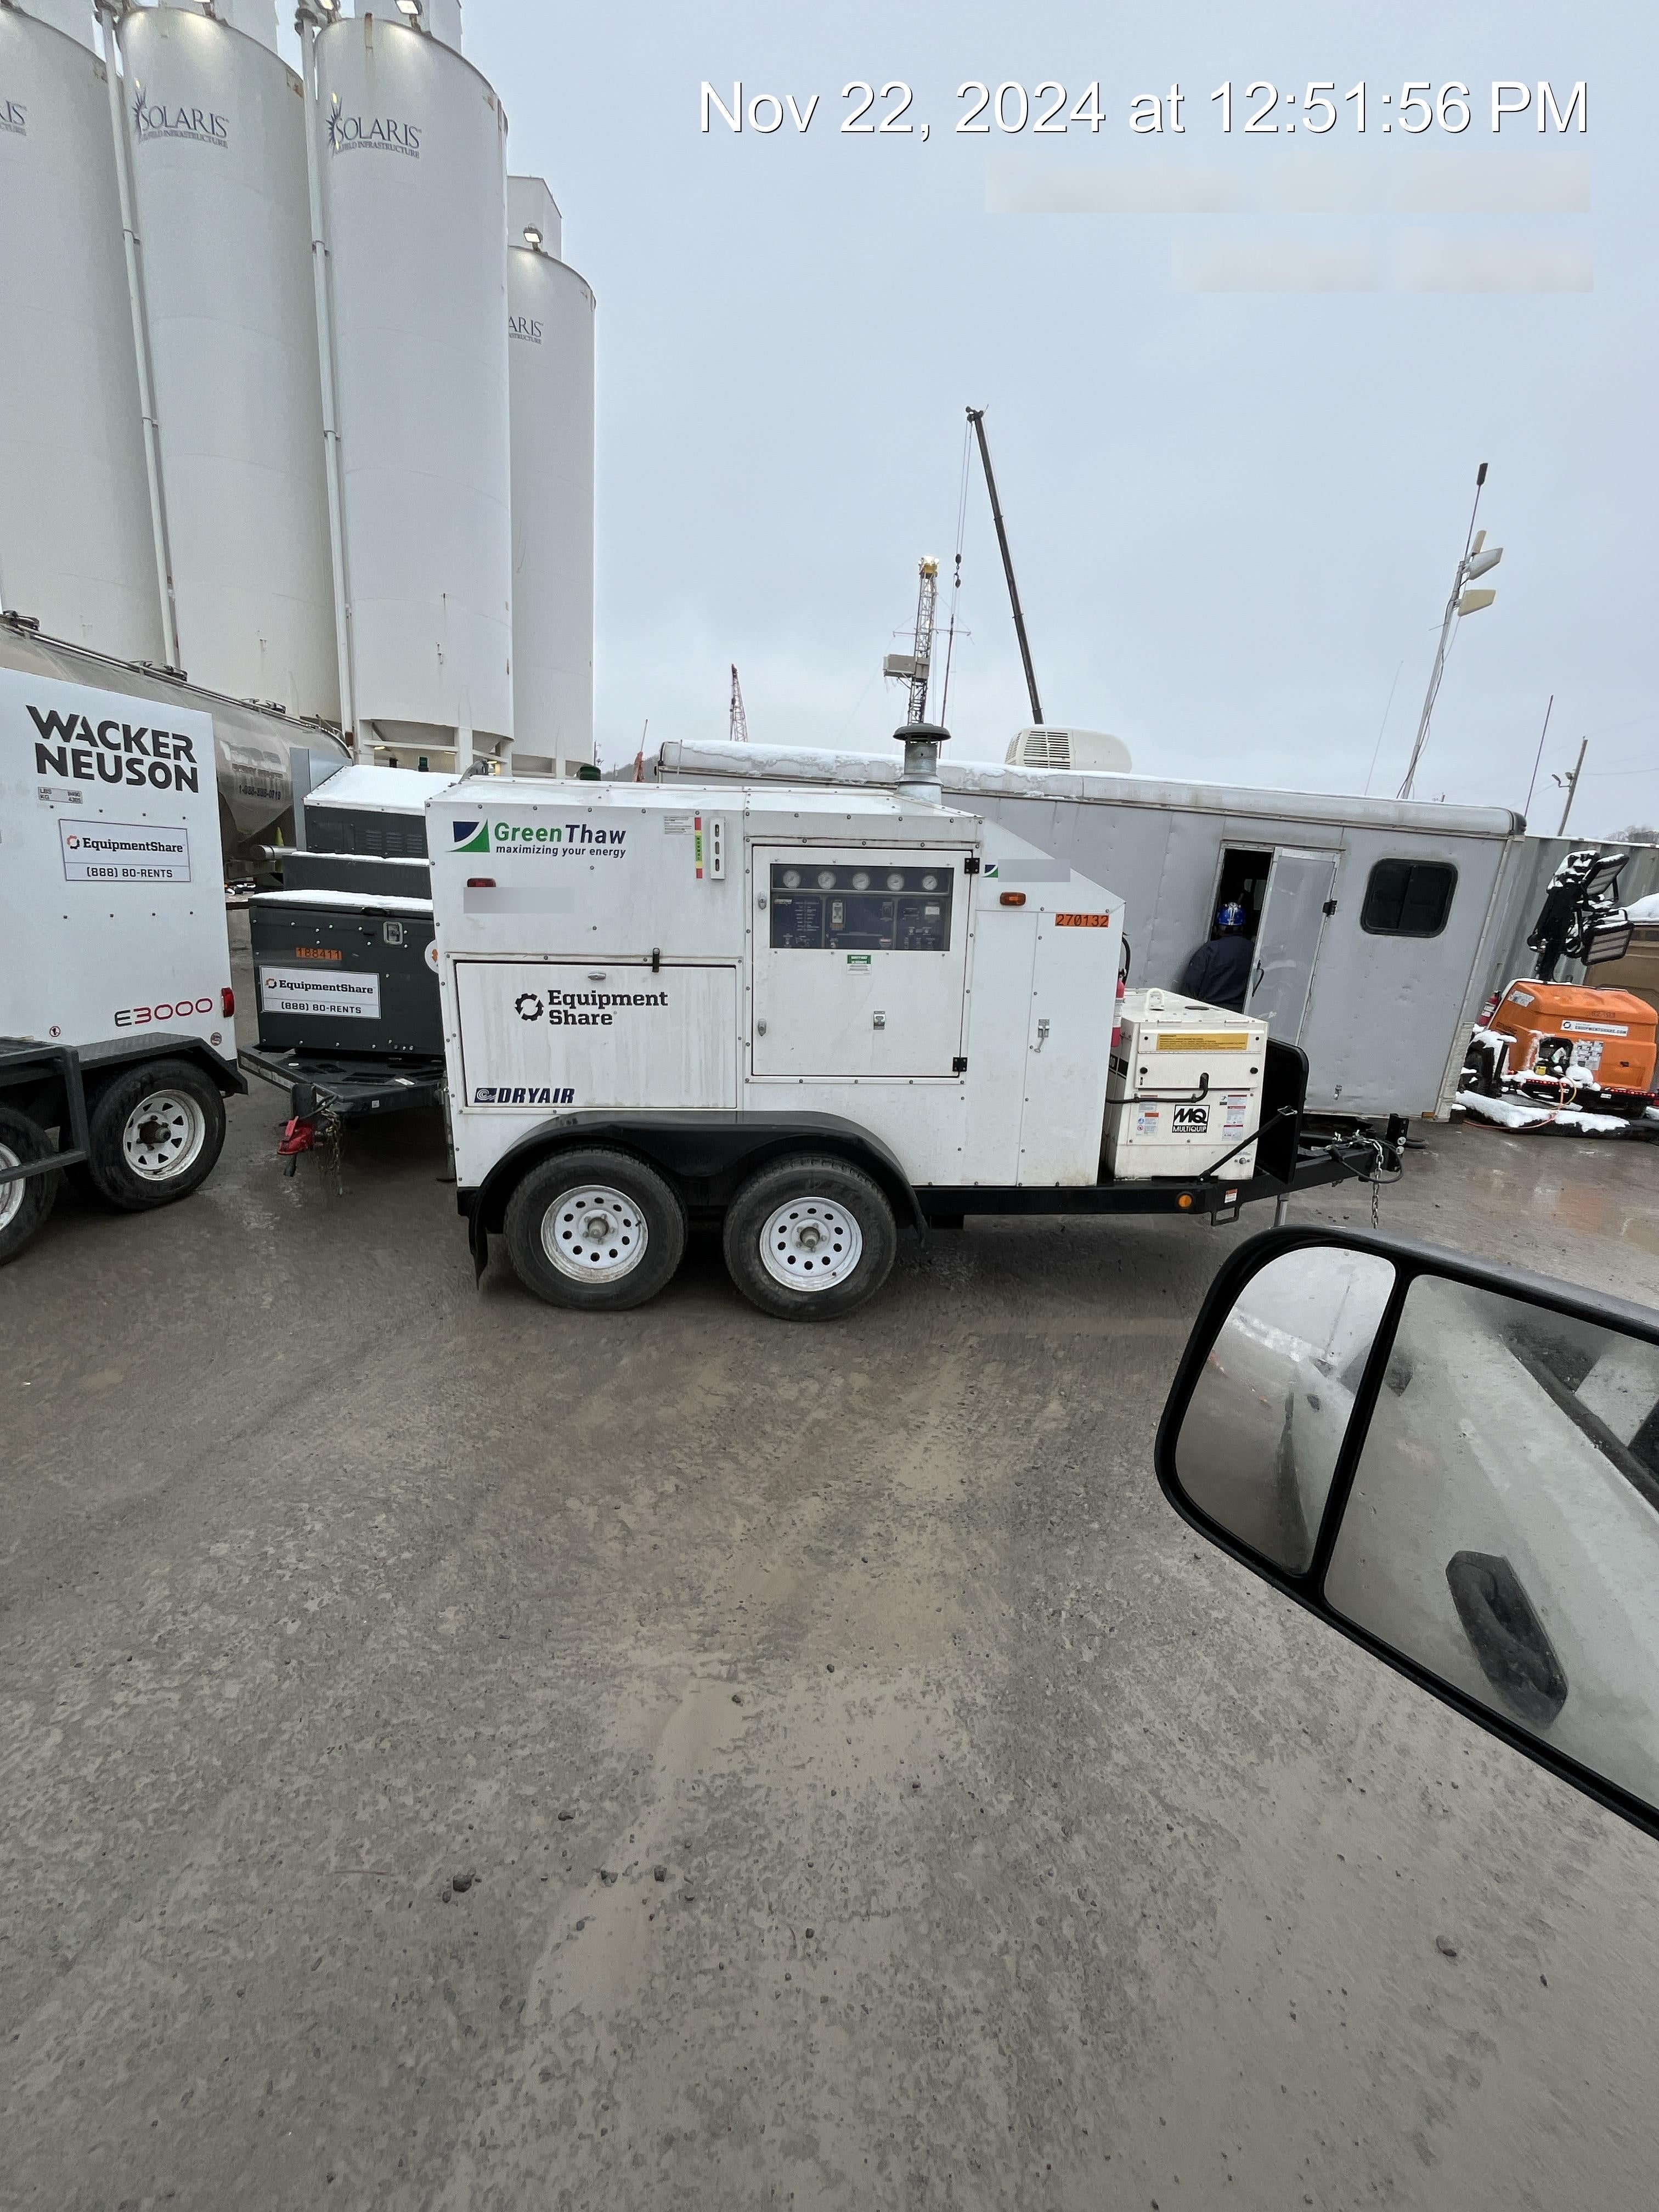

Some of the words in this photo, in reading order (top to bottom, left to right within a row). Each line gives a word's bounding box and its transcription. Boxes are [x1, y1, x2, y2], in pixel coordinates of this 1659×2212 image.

[140, 105, 227, 138] SOLARIS
[336, 116, 419, 149] SOLARIS
[26, 704, 198, 764] WACKER
[35, 742, 199, 793] NEUSON
[82, 837, 183, 853] EquipmentShare
[496, 844, 558, 856] maximizing
[562, 847, 586, 857] your
[589, 848, 627, 859] energy
[87, 867, 118, 878] (888)
[122, 868, 173, 878] 80-RENTS
[1056, 914, 1109, 928] 270132
[297, 948, 343, 960] 188411
[279, 980, 374, 994] EquipmentShare
[548, 990, 668, 1009] Equipment
[114, 998, 213, 1027] E3000
[281, 1002, 309, 1011] (888)
[312, 1005, 362, 1014] 80-RENTS
[549, 1009, 613, 1025] Share
[498, 1088, 575, 1104] DRYAIR
[1173, 1108, 1207, 1124] MQ
